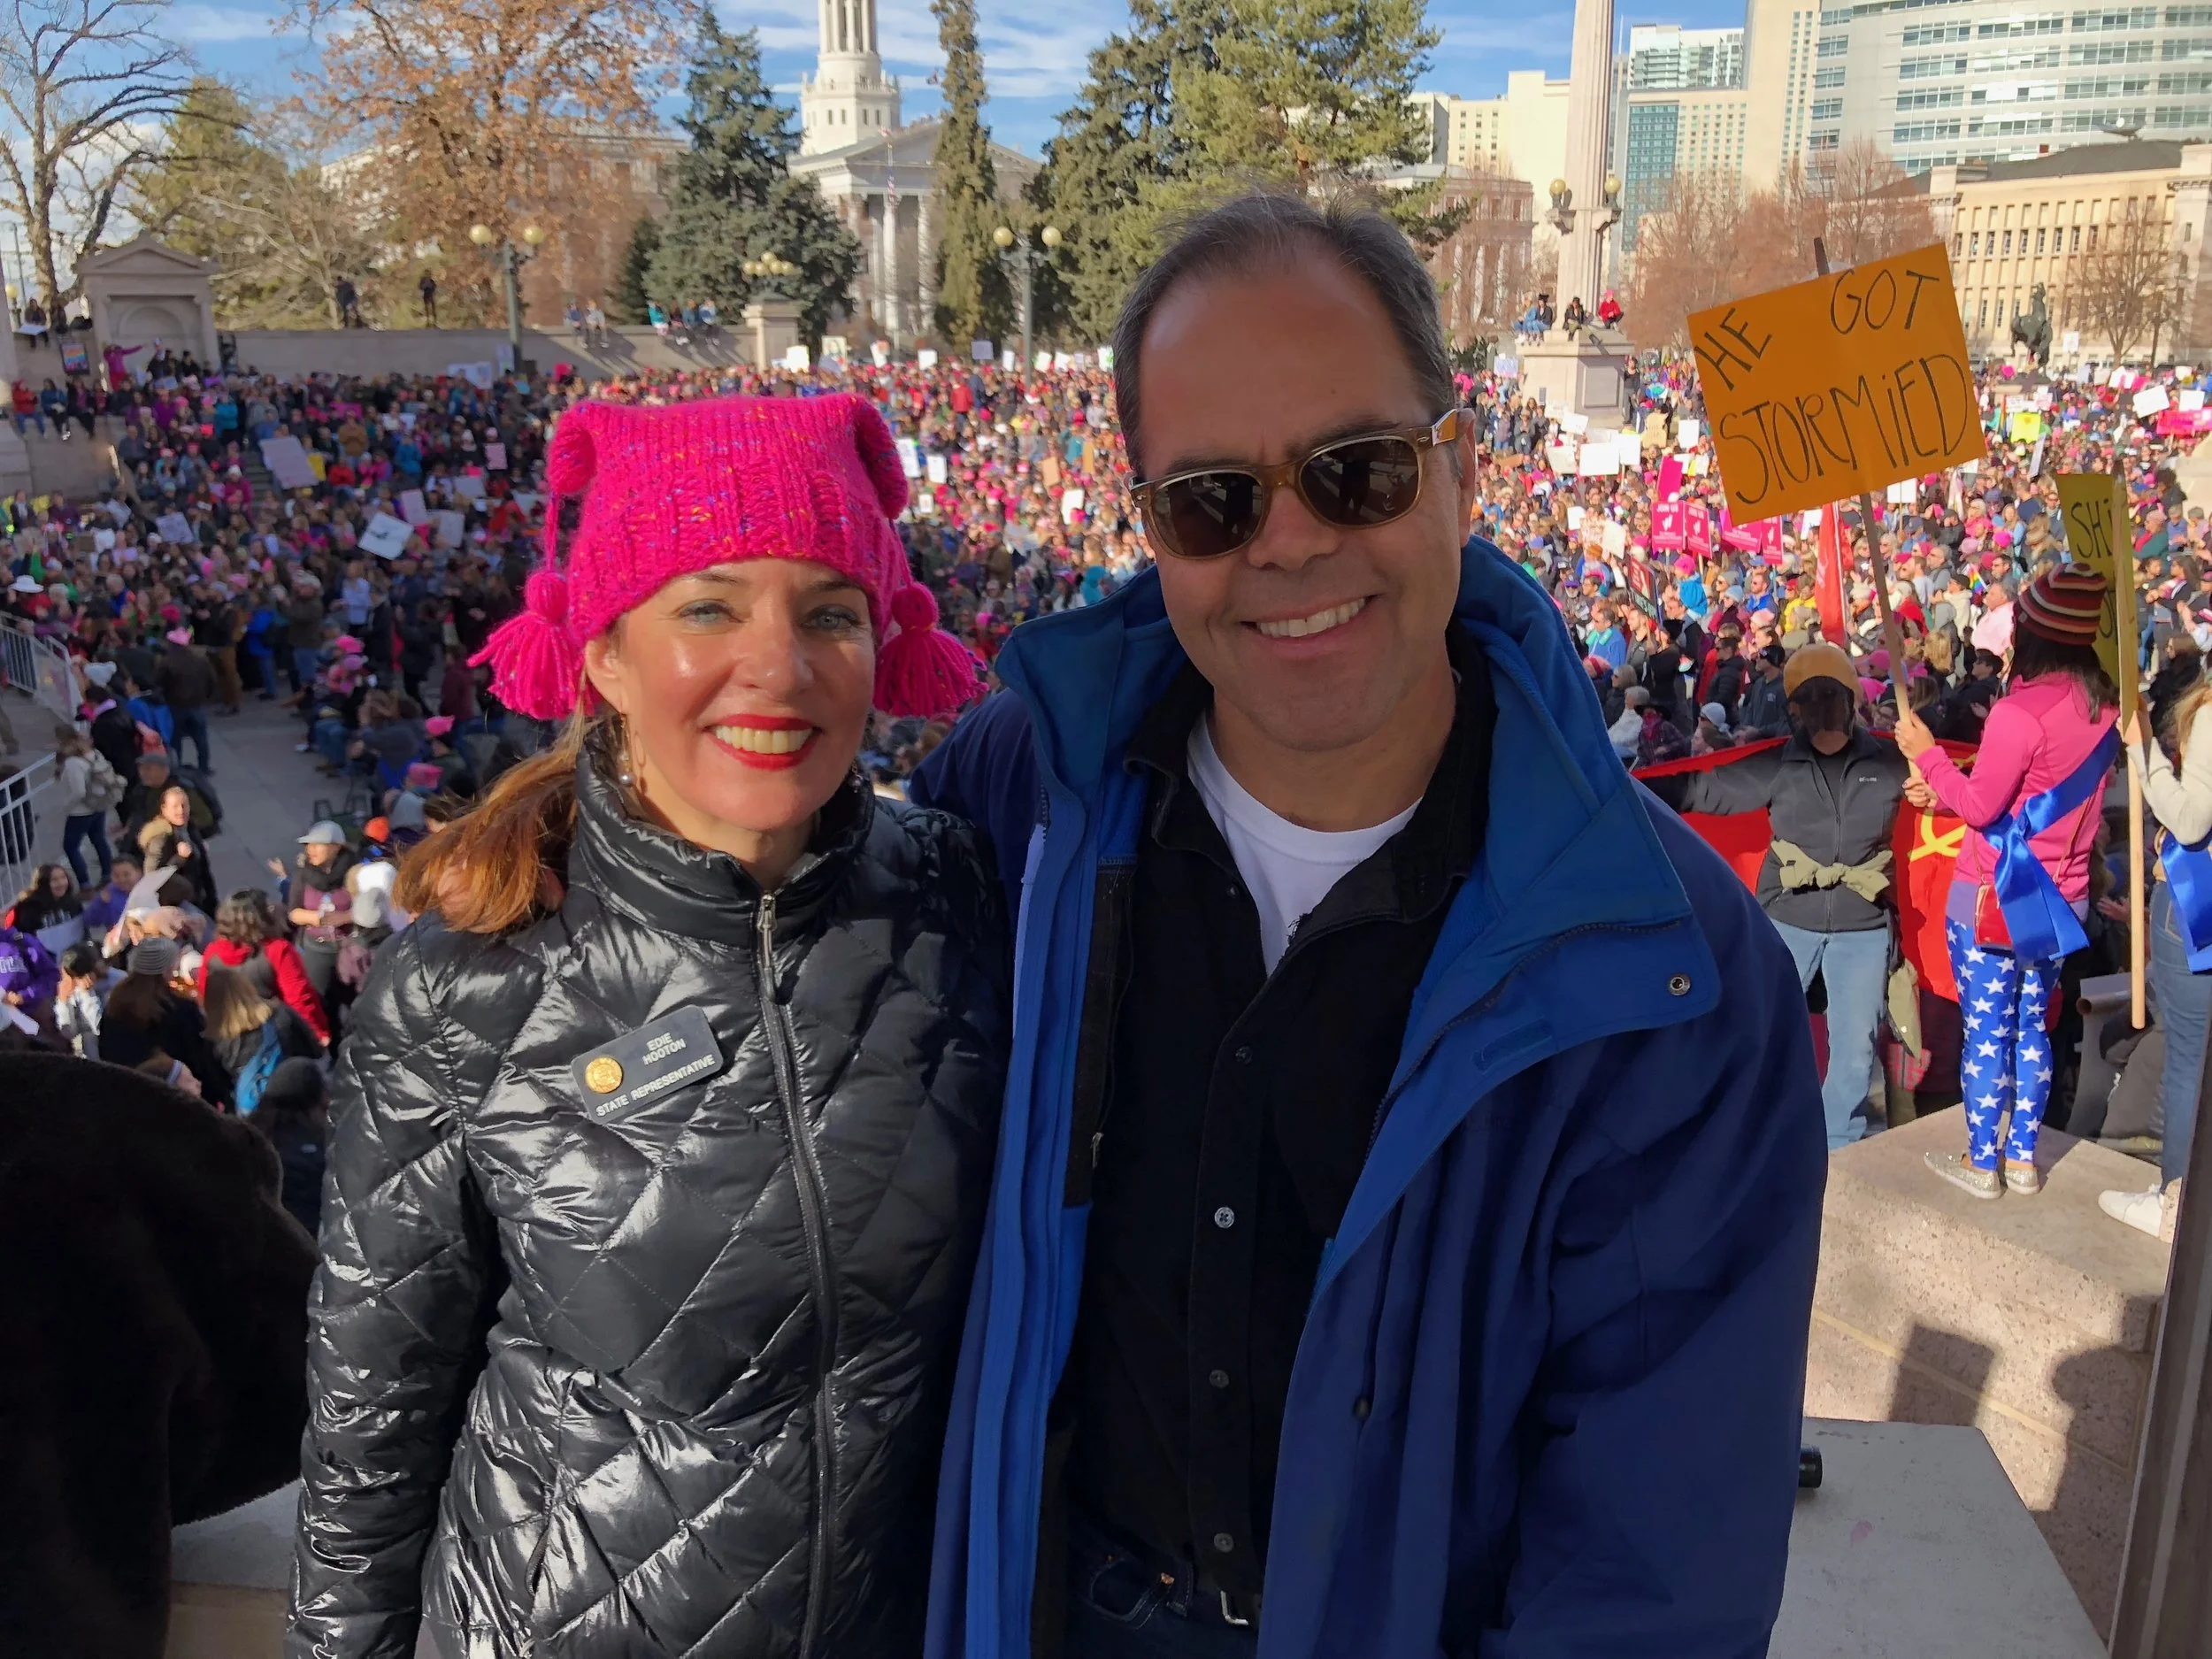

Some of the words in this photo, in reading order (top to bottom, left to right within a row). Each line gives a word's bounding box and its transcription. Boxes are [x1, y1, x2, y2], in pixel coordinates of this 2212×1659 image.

[1694, 307, 1772, 392] HE
[1829, 268, 1940, 335] GOT
[641, 1038, 687, 1065] HOOTON
[646, 1032, 673, 1051] EDIE
[595, 1094, 630, 1117] STATE
[630, 1054, 716, 1101] REPRESENTATIVE
